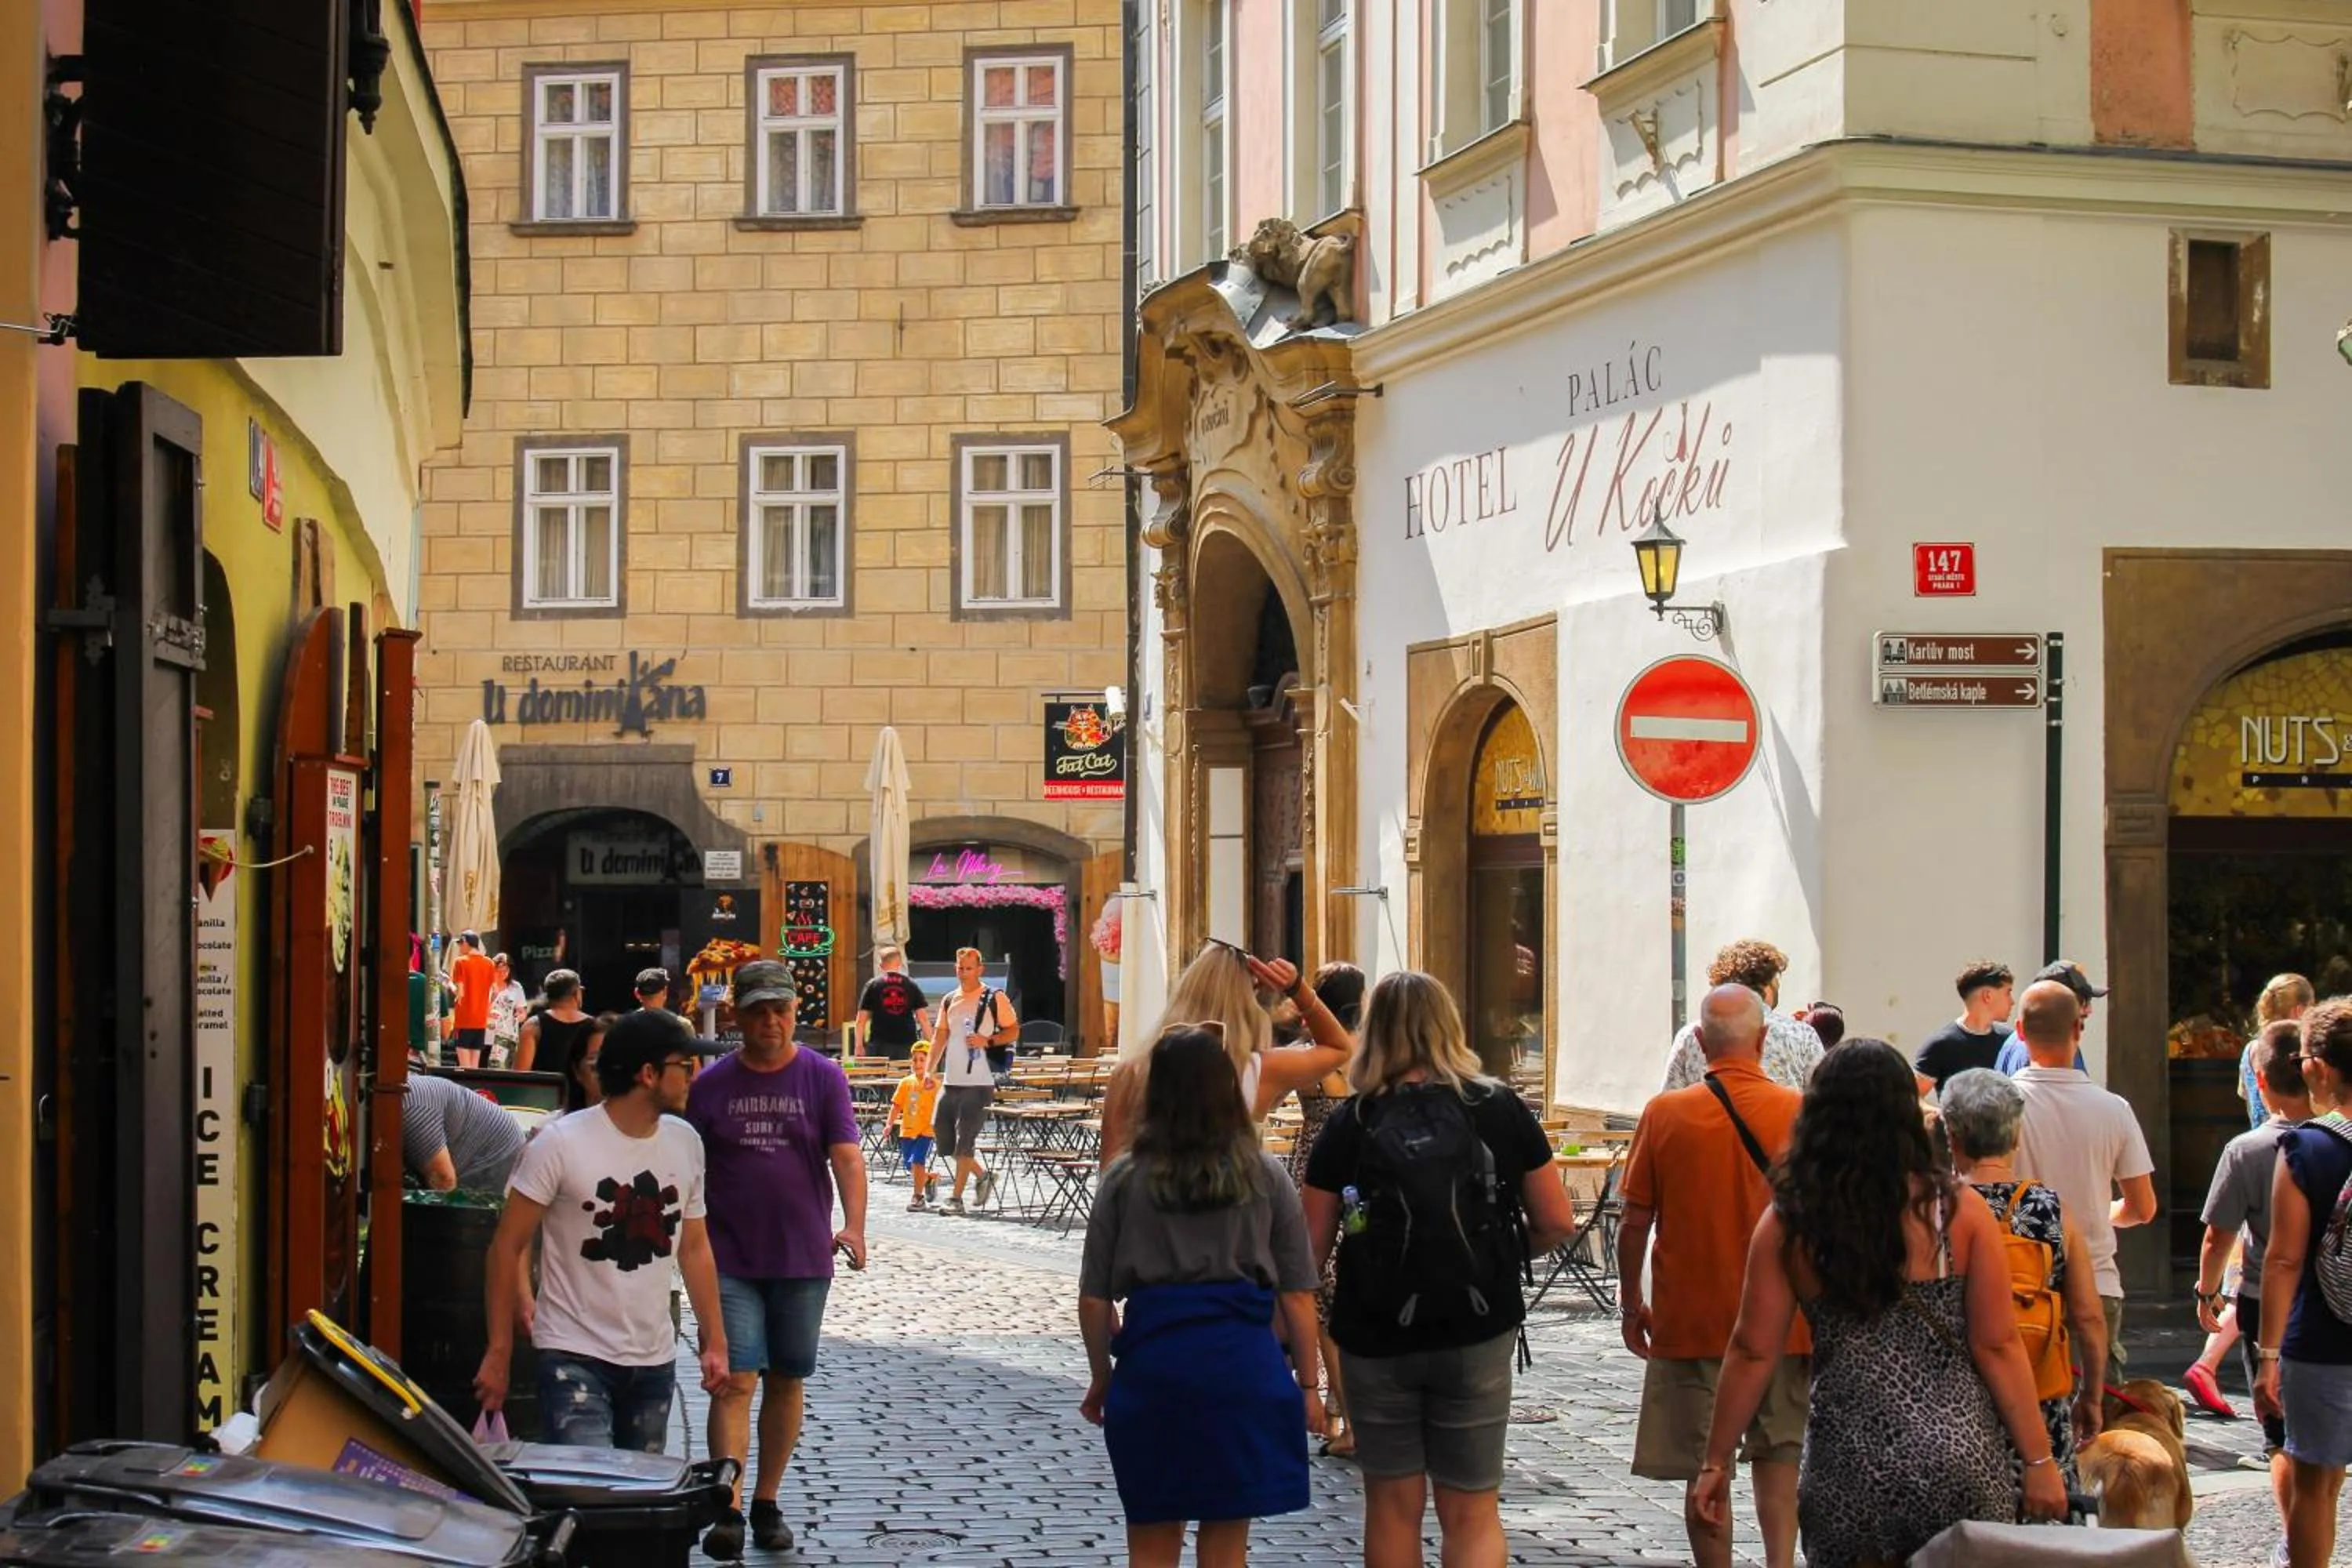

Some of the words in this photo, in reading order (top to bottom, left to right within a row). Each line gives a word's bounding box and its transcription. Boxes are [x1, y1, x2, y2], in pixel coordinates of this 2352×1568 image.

[1569, 340, 1661, 416] PALÁC
[1405, 446, 1517, 539] HOTEL
[1545, 424, 1598, 552] U
[1929, 550, 1961, 572] 147
[1908, 642, 1944, 660] Karlův
[1948, 643, 1975, 660] most
[503, 655, 616, 672] RESTAURANT
[1908, 681, 1958, 700] Betlémská
[1961, 682, 1987, 705] kaple
[2241, 716, 2340, 764] NUTS
[1082, 753, 1116, 777] Cat
[717, 772, 724, 783] 7
[197, 919, 225, 927] anilla
[197, 941, 231, 949] ocolate
[197, 986, 231, 995] ocolate
[198, 1009, 223, 1018] alted
[197, 1066, 220, 1185] ICE
[197, 1222, 221, 1428] CREAM
